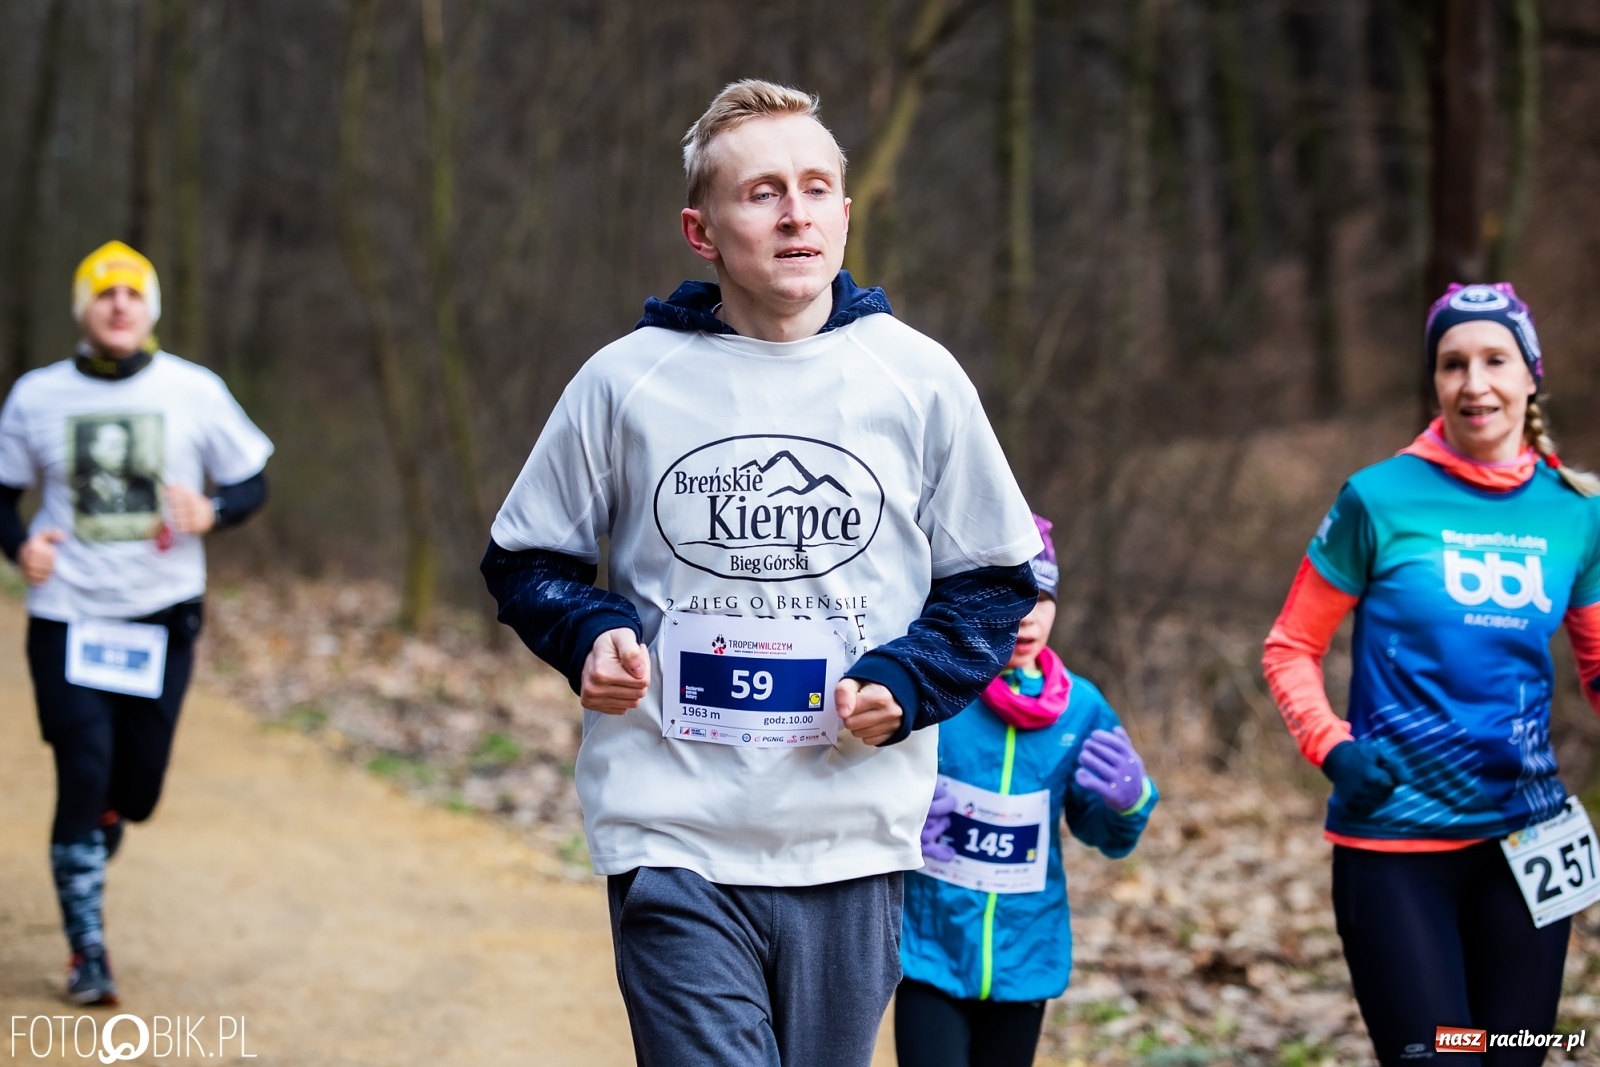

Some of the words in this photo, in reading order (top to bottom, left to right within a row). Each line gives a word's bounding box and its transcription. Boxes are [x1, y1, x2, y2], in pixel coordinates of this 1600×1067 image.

[674, 467, 764, 495] Breńskie
[707, 495, 861, 552] Kierpce
[730, 555, 761, 573] Bieg
[764, 553, 809, 571] Górski
[1443, 549, 1553, 614] bbl
[689, 596, 738, 610] BIEG
[750, 596, 764, 609] O
[776, 594, 867, 610] BREŃSKIE
[728, 639, 793, 651] TROPEMWILCZYM
[730, 669, 774, 700] 59
[682, 706, 708, 718] 1963
[710, 710, 721, 720] m
[763, 715, 814, 726] godz.10.00
[964, 828, 1015, 858] 145
[1523, 834, 1596, 904] 257
